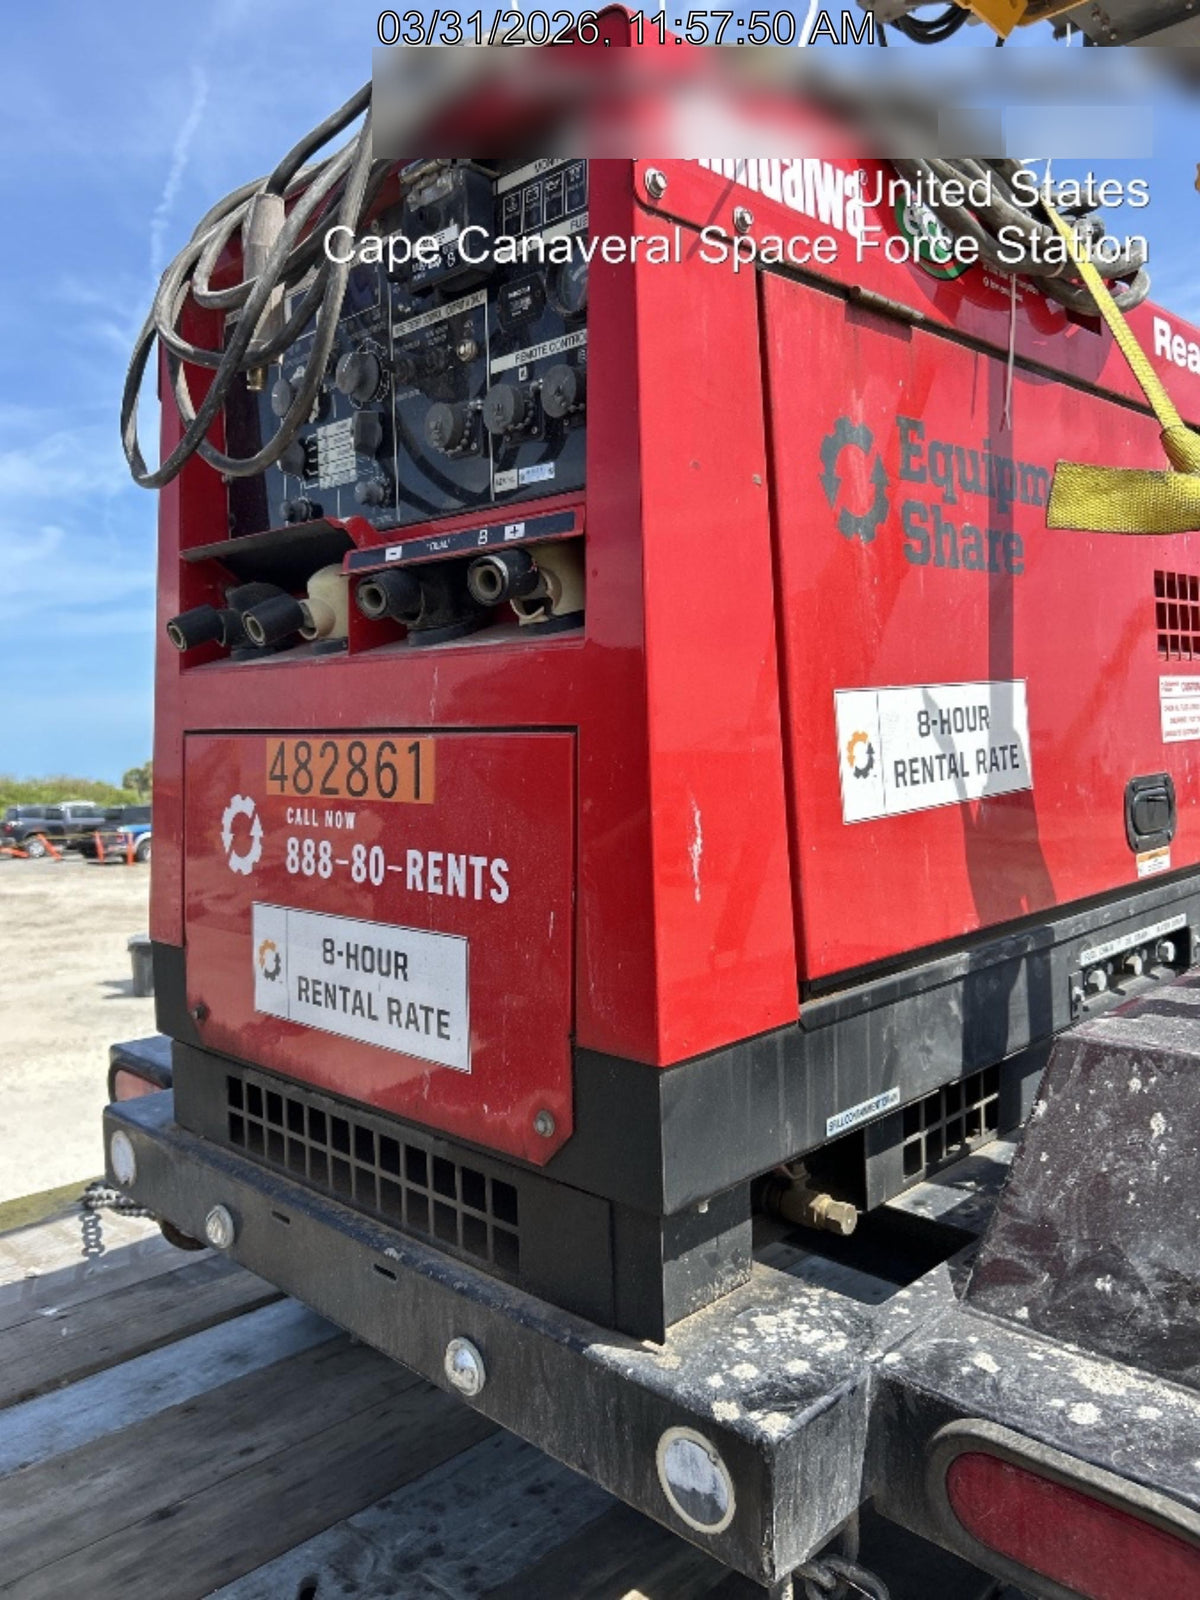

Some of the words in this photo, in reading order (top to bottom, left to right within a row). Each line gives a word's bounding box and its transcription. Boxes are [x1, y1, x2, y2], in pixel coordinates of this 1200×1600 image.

[684, 158, 865, 240] daiwa
[1153, 316, 1200, 376] Rea
[901, 500, 1025, 575] Share
[917, 705, 990, 738] 8-HOUR
[268, 740, 422, 800] 482861
[894, 751, 970, 789] RENTAL
[976, 744, 1020, 775] RATE
[286, 807, 319, 827] CALL
[324, 809, 356, 830] NOW
[286, 836, 510, 904] 888-80-RENTS
[322, 937, 409, 982] 8-HOUR
[297, 975, 379, 1022] RENTAL
[387, 996, 451, 1041] RATE
